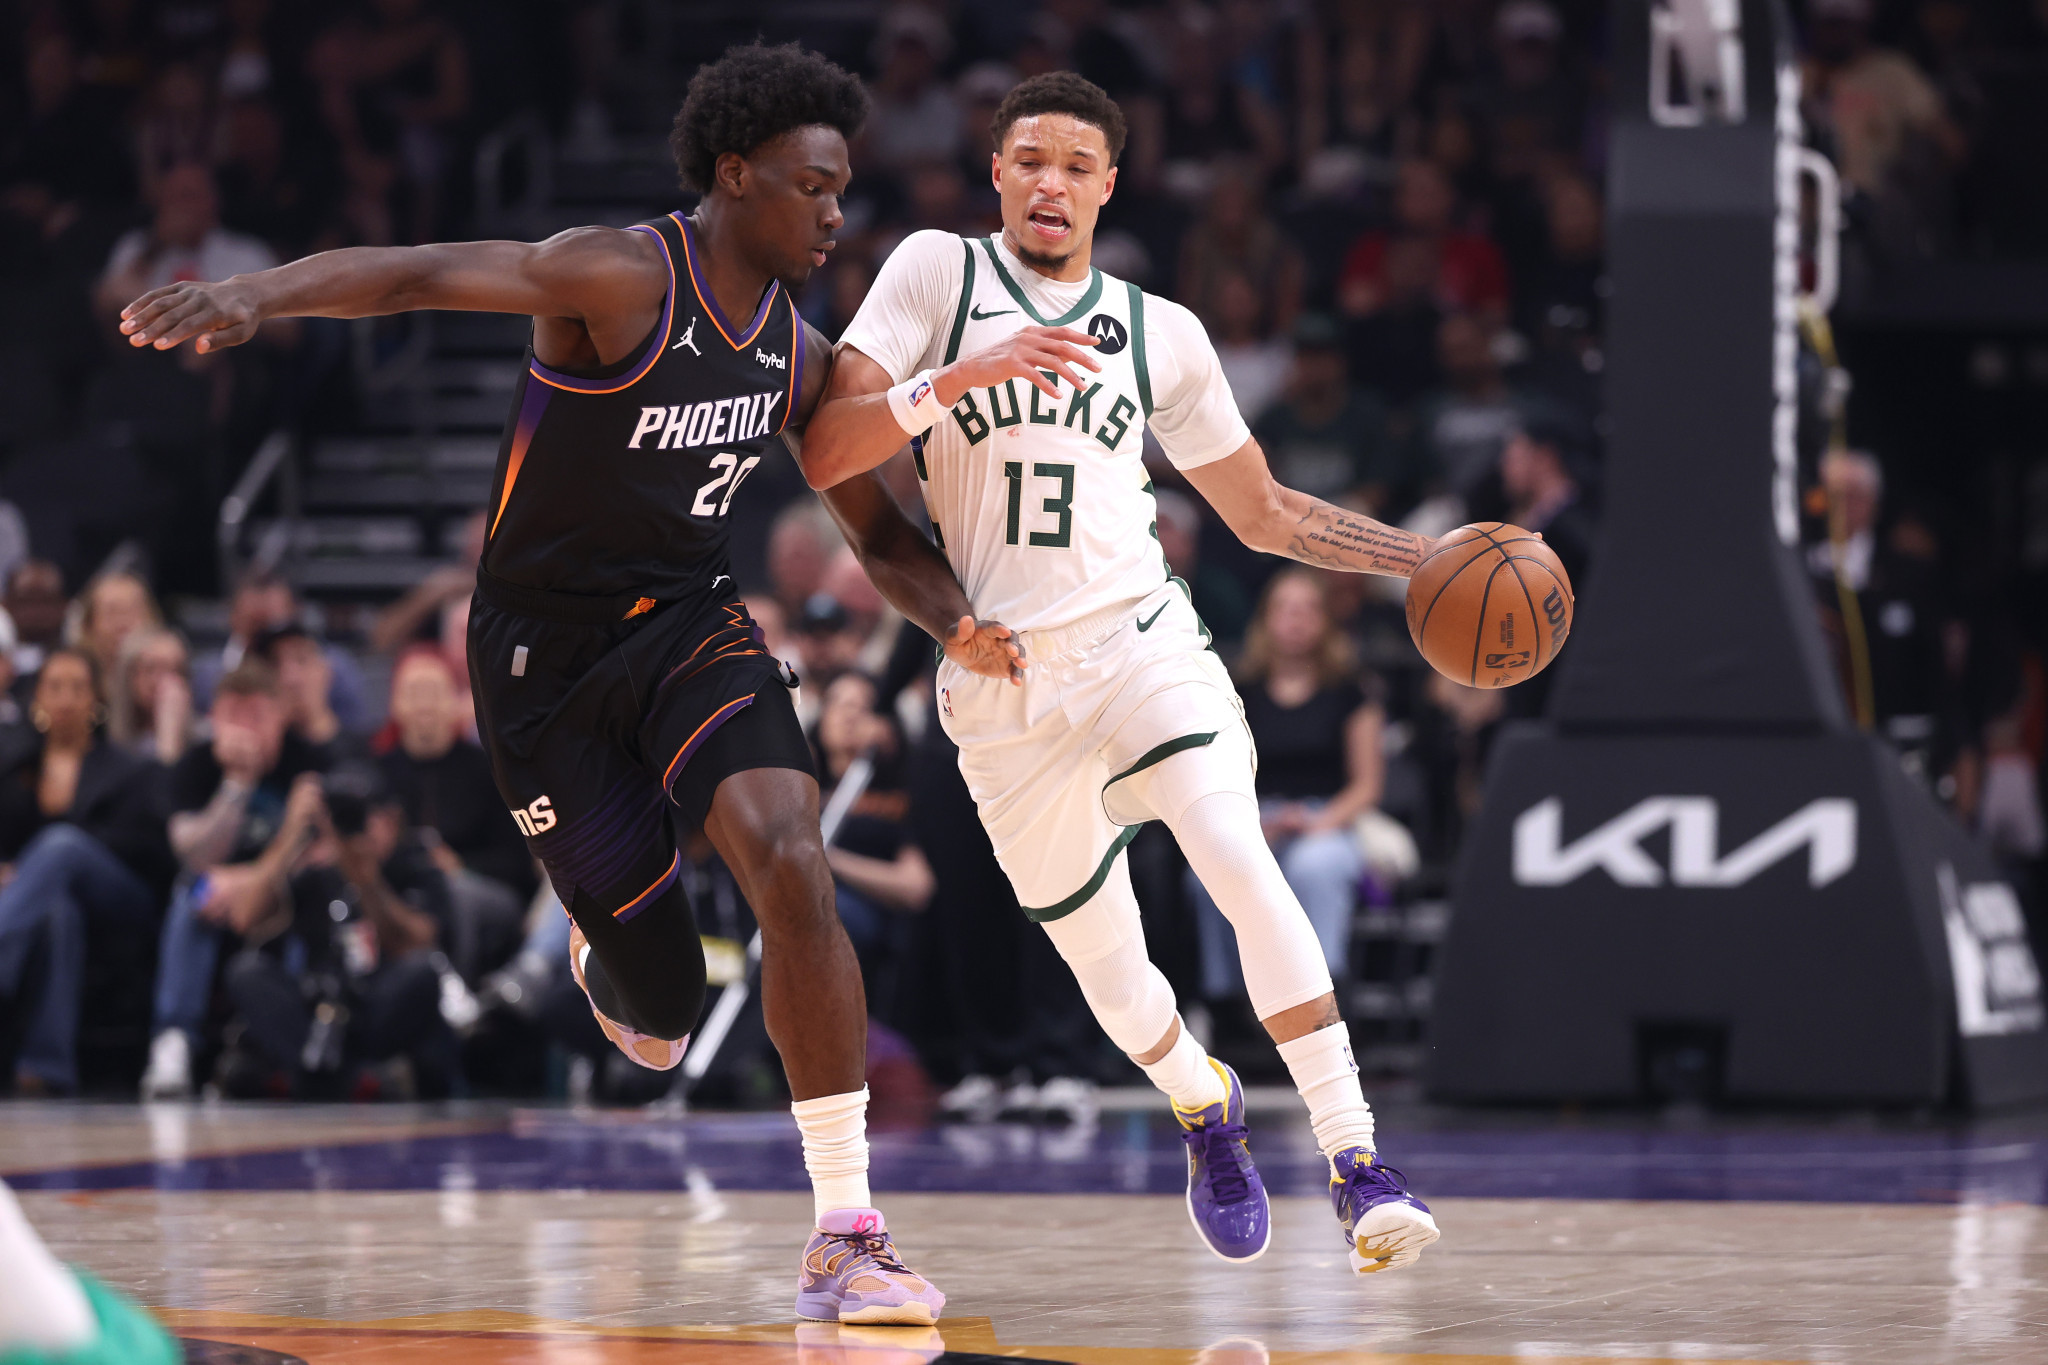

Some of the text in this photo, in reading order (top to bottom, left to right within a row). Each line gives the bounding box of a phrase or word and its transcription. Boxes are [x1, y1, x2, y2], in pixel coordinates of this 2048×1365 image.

[755, 348, 786, 370] PayPal
[627, 390, 784, 450] PHOENIX
[951, 370, 1138, 452] BUCKS
[1003, 461, 1076, 549] 13
